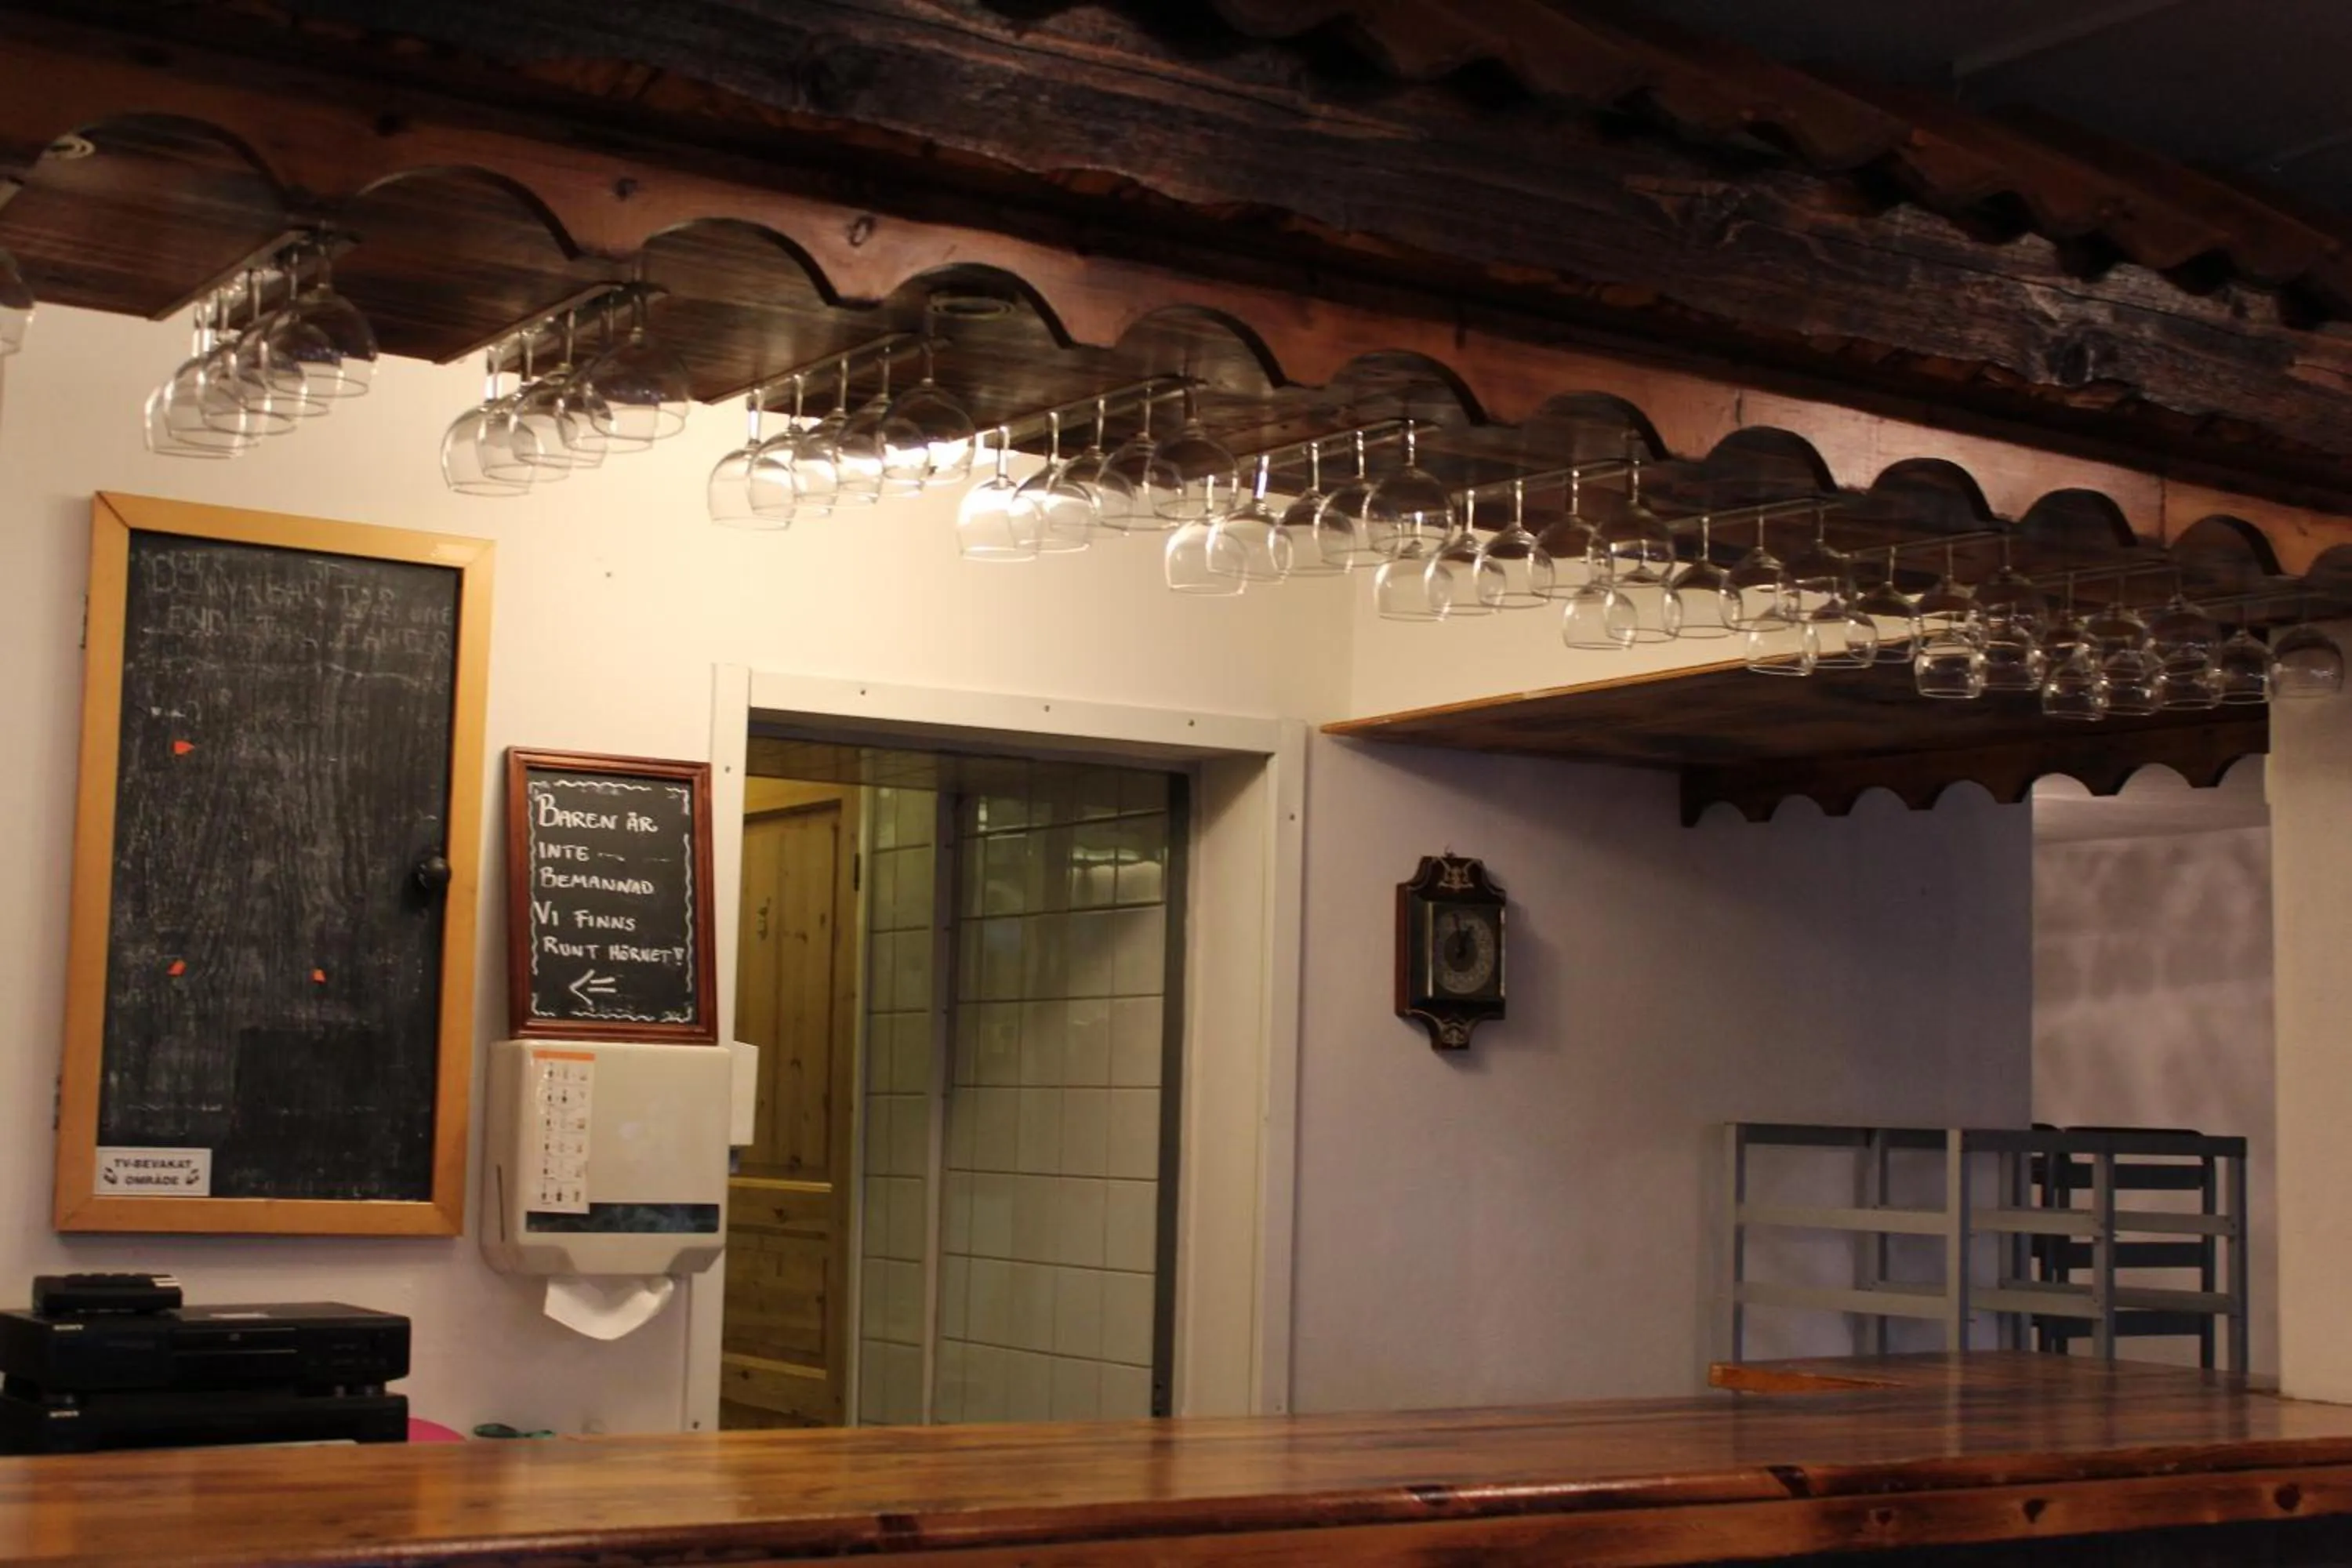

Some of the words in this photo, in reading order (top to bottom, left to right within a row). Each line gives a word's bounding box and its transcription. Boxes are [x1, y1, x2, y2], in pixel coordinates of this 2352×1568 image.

[535, 793, 618, 830] BAREN
[539, 841, 590, 862] INTE
[540, 866, 655, 895] BEMANNAD
[574, 909, 637, 932] FINNS
[543, 935, 600, 960] RUNT
